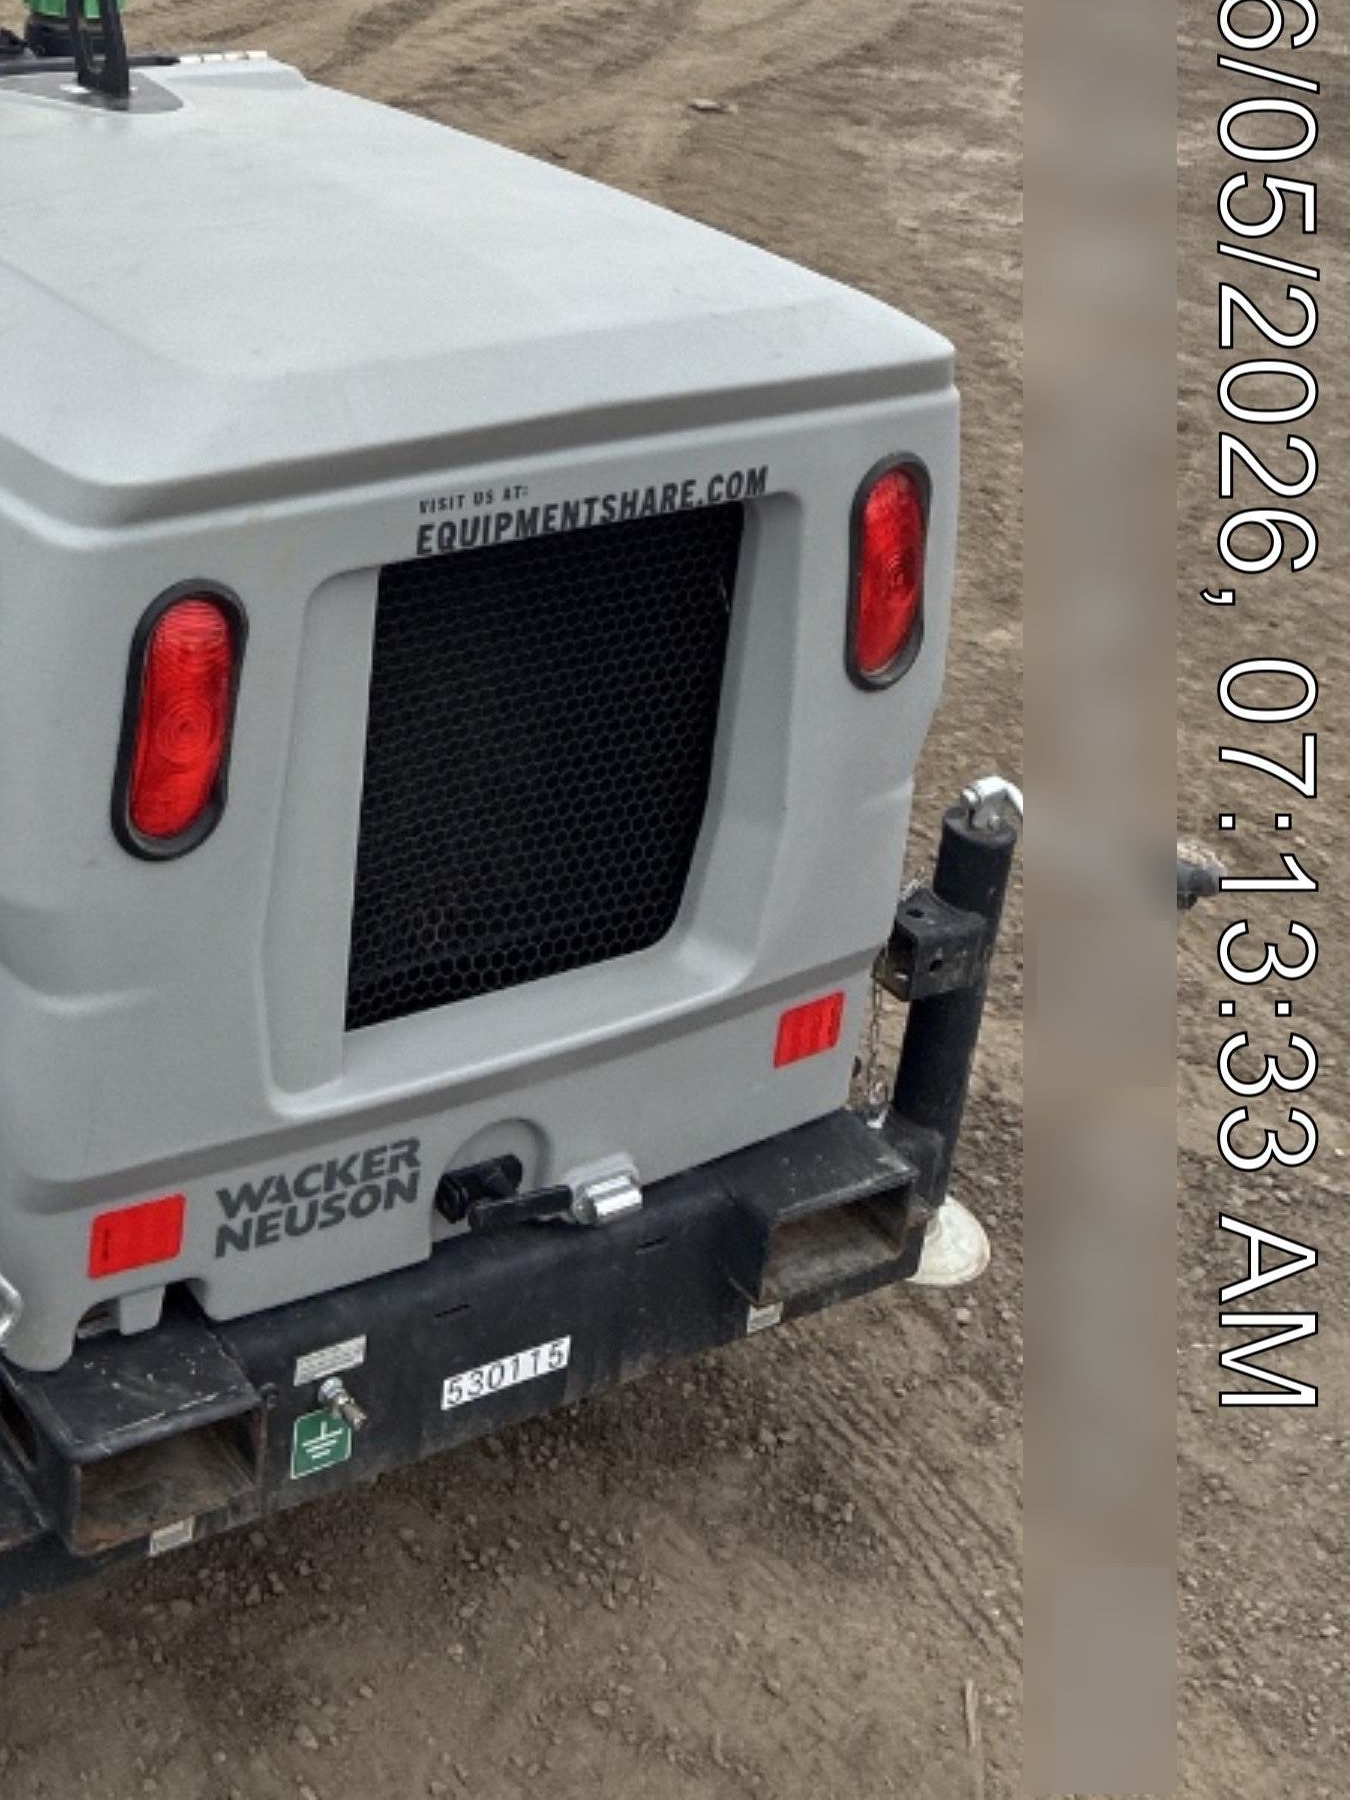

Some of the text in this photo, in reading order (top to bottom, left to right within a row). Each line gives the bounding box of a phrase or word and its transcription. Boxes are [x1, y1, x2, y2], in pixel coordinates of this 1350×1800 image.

[416, 465, 769, 555] EQUIPMENTSHARE.COM
[419, 494, 466, 514] VISIT
[473, 489, 494, 507] US
[214, 1170, 421, 1259] NEUSON
[215, 1136, 421, 1229] WACKER
[446, 1342, 566, 1404] 530115
